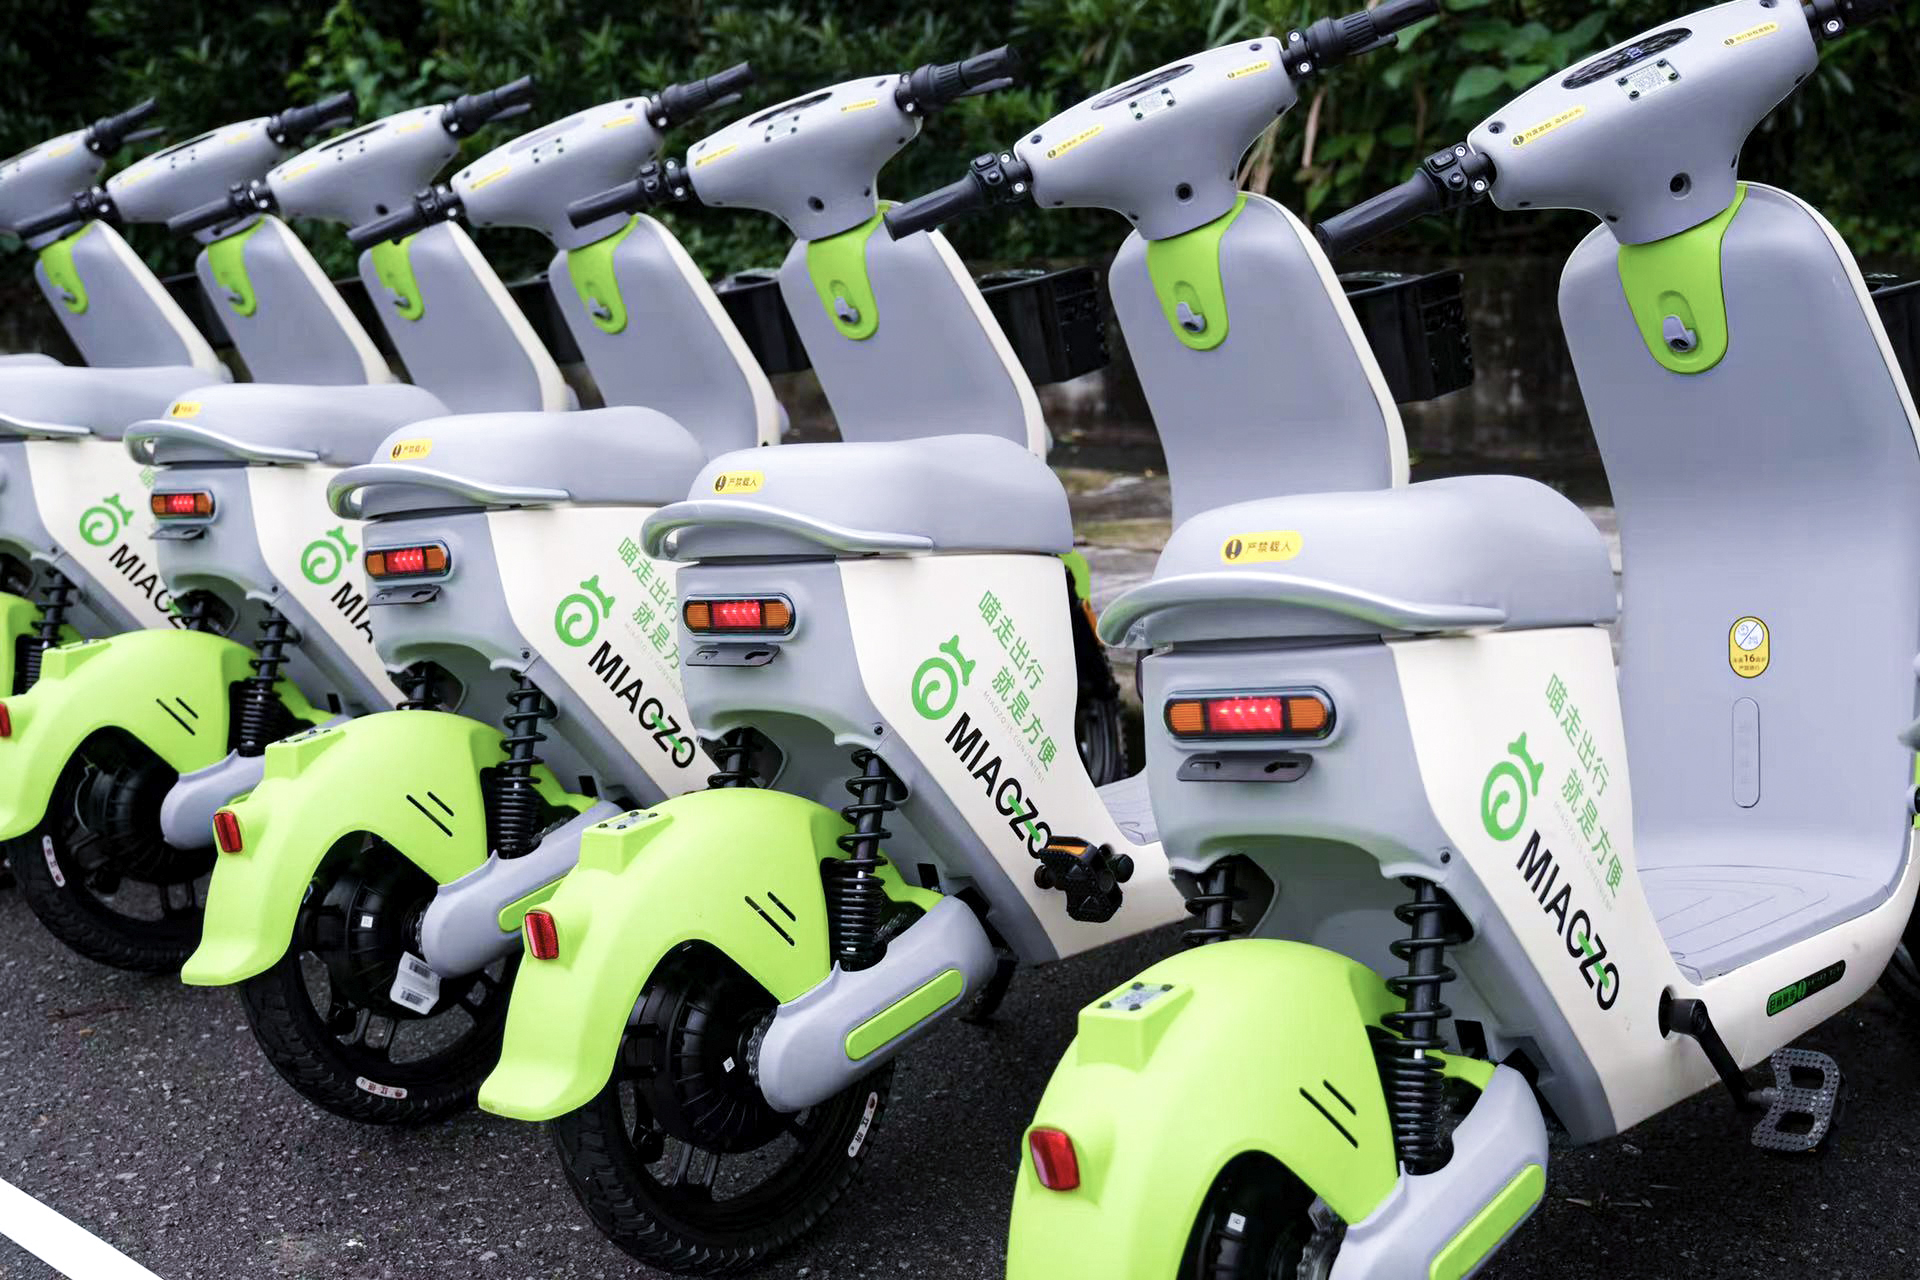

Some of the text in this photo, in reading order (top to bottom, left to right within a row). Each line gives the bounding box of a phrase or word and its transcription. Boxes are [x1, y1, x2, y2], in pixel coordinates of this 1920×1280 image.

[1246, 541, 1292, 554] 严禁载人
[978, 590, 1045, 690] 喵走出行
[588, 640, 696, 768] MIAOZO
[991, 665, 1057, 772] 就是方便
[1545, 672, 1610, 797] 喵走出行
[945, 711, 1052, 860] MIAOZO
[1561, 768, 1624, 898] 就是方便
[1516, 829, 1620, 1011] MIAOZO
